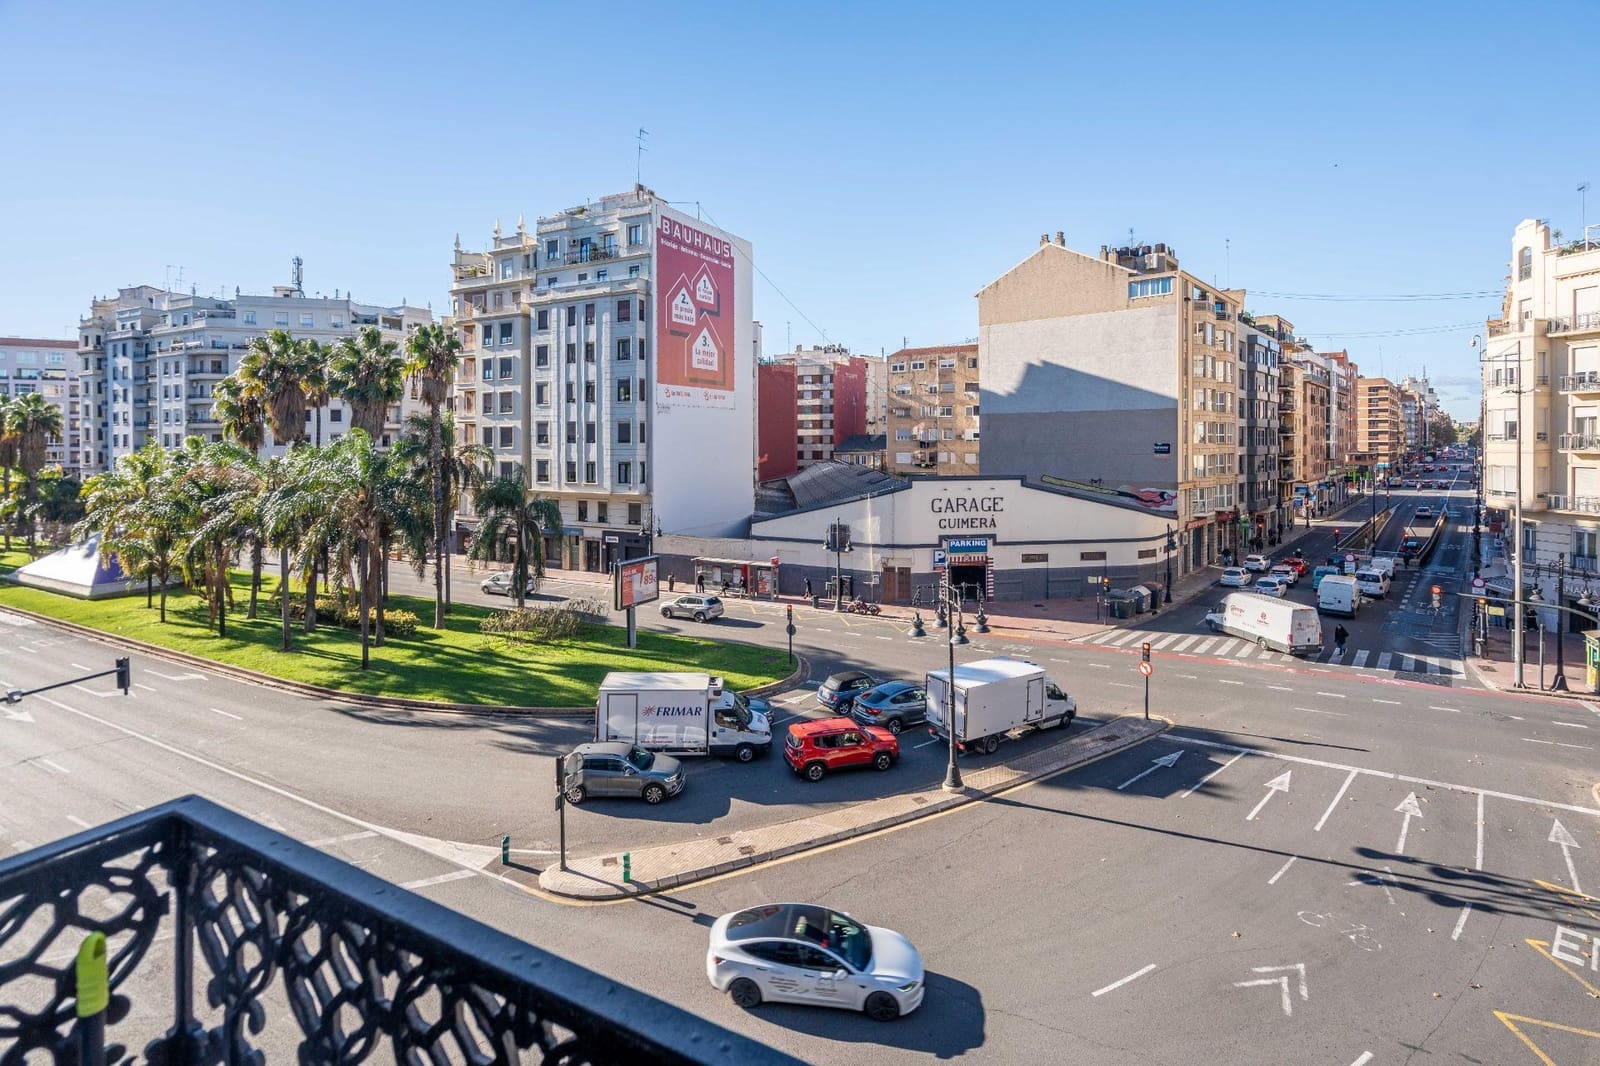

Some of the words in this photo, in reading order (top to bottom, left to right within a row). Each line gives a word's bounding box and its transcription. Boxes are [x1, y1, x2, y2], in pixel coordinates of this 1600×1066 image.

[663, 219, 729, 258] BAUHAUS
[681, 293, 689, 305] 2.
[702, 335, 710, 347] 3.
[931, 497, 1004, 513] GARAGE
[934, 550, 945, 562] P
[656, 706, 702, 717] FRIMAR
